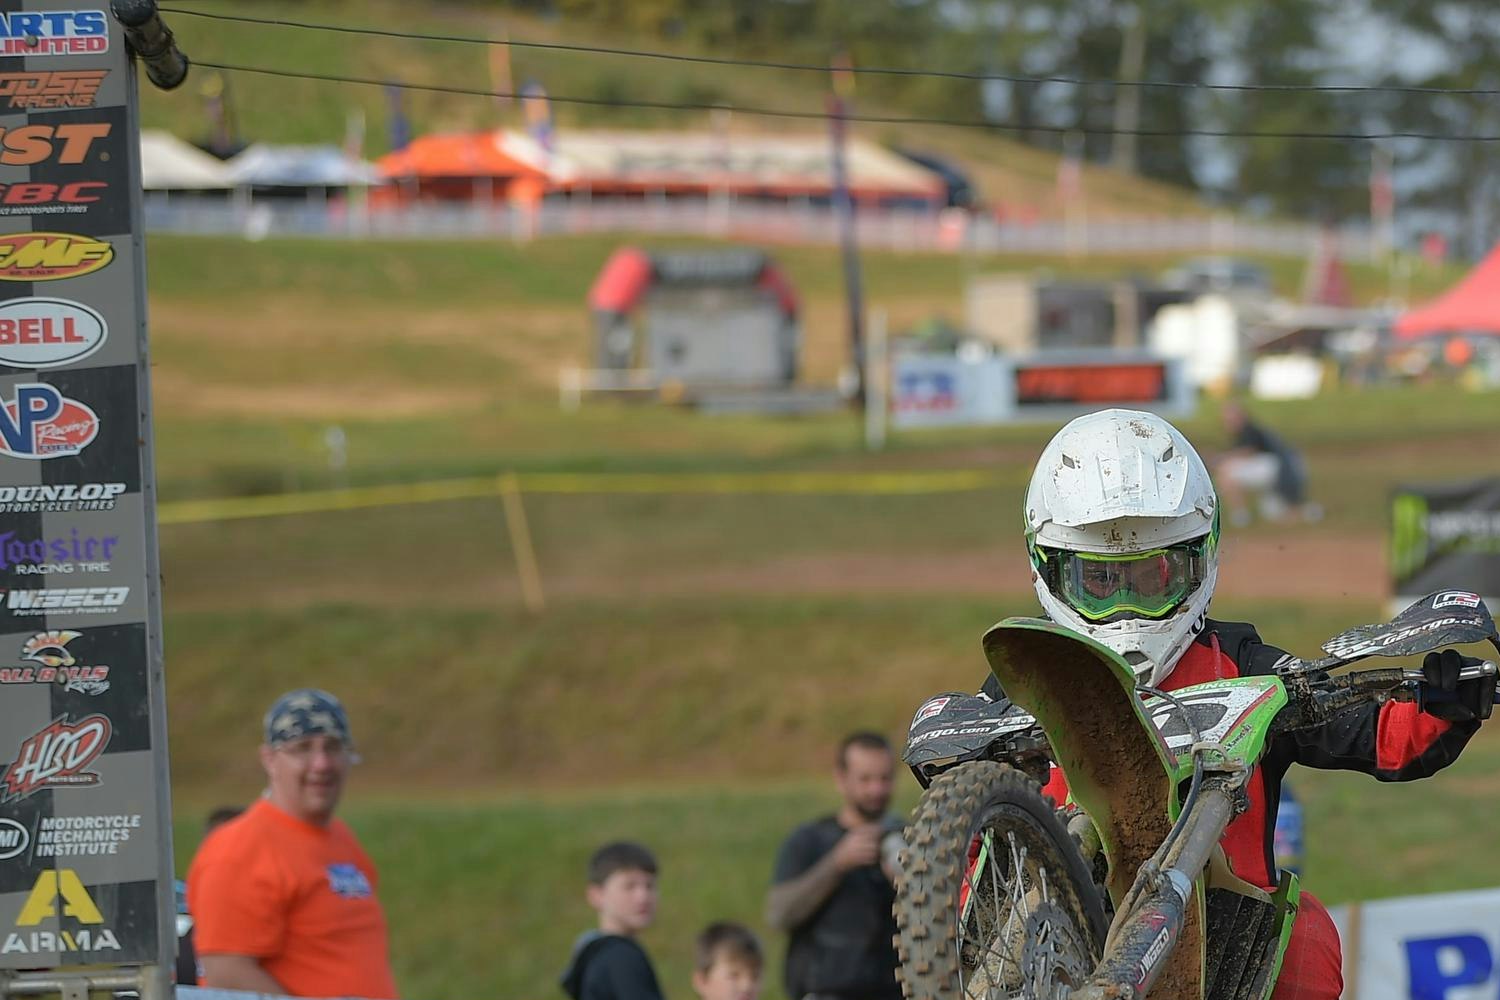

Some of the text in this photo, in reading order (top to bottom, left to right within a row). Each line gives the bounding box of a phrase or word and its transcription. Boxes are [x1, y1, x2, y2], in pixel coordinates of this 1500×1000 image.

[0, 37, 106, 54] IMITED
[0, 123, 112, 165] ST
[0, 181, 108, 204] BC
[0, 317, 84, 345] BELL
[0, 483, 127, 502] DUNLOP
[0, 500, 116, 513] OTORCYCLE TIRES
[16, 561, 111, 575] RACING TIRE
[0, 668, 34, 683] ALL
[41, 814, 141, 831] MOTORCYCLE
[39, 828, 130, 844] MECHANICS
[36, 842, 119, 857] INSTITUTE
